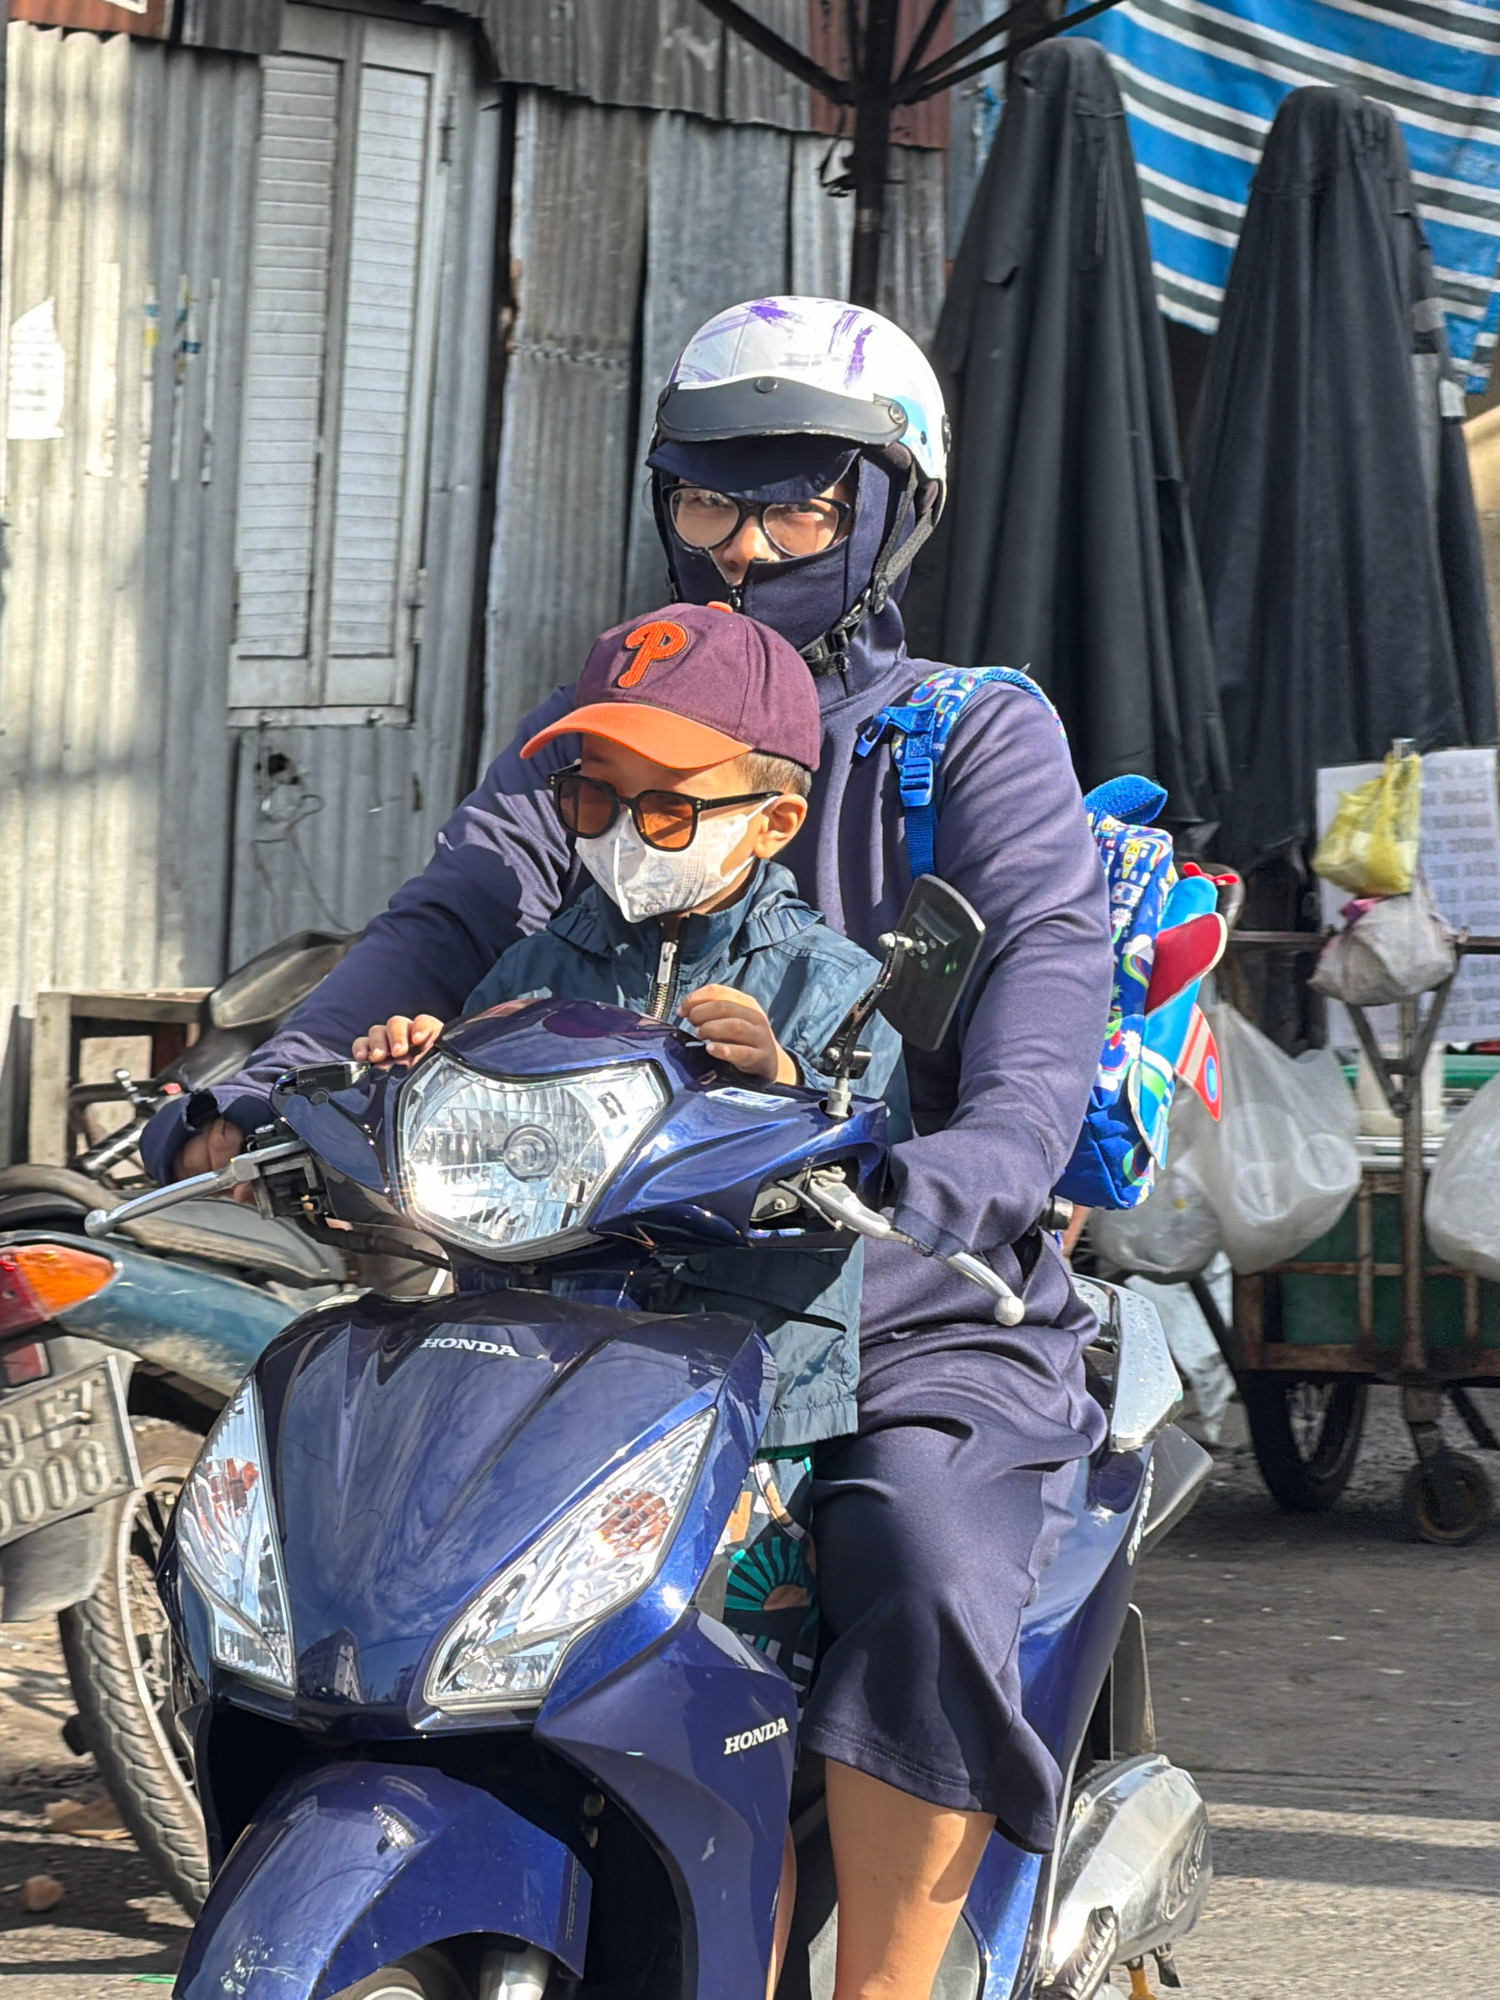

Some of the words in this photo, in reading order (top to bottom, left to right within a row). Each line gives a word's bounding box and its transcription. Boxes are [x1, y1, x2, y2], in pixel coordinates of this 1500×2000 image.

[617, 620, 689, 689] P
[420, 1337, 520, 1357] HONDA
[723, 1717, 789, 1755] HONDA
